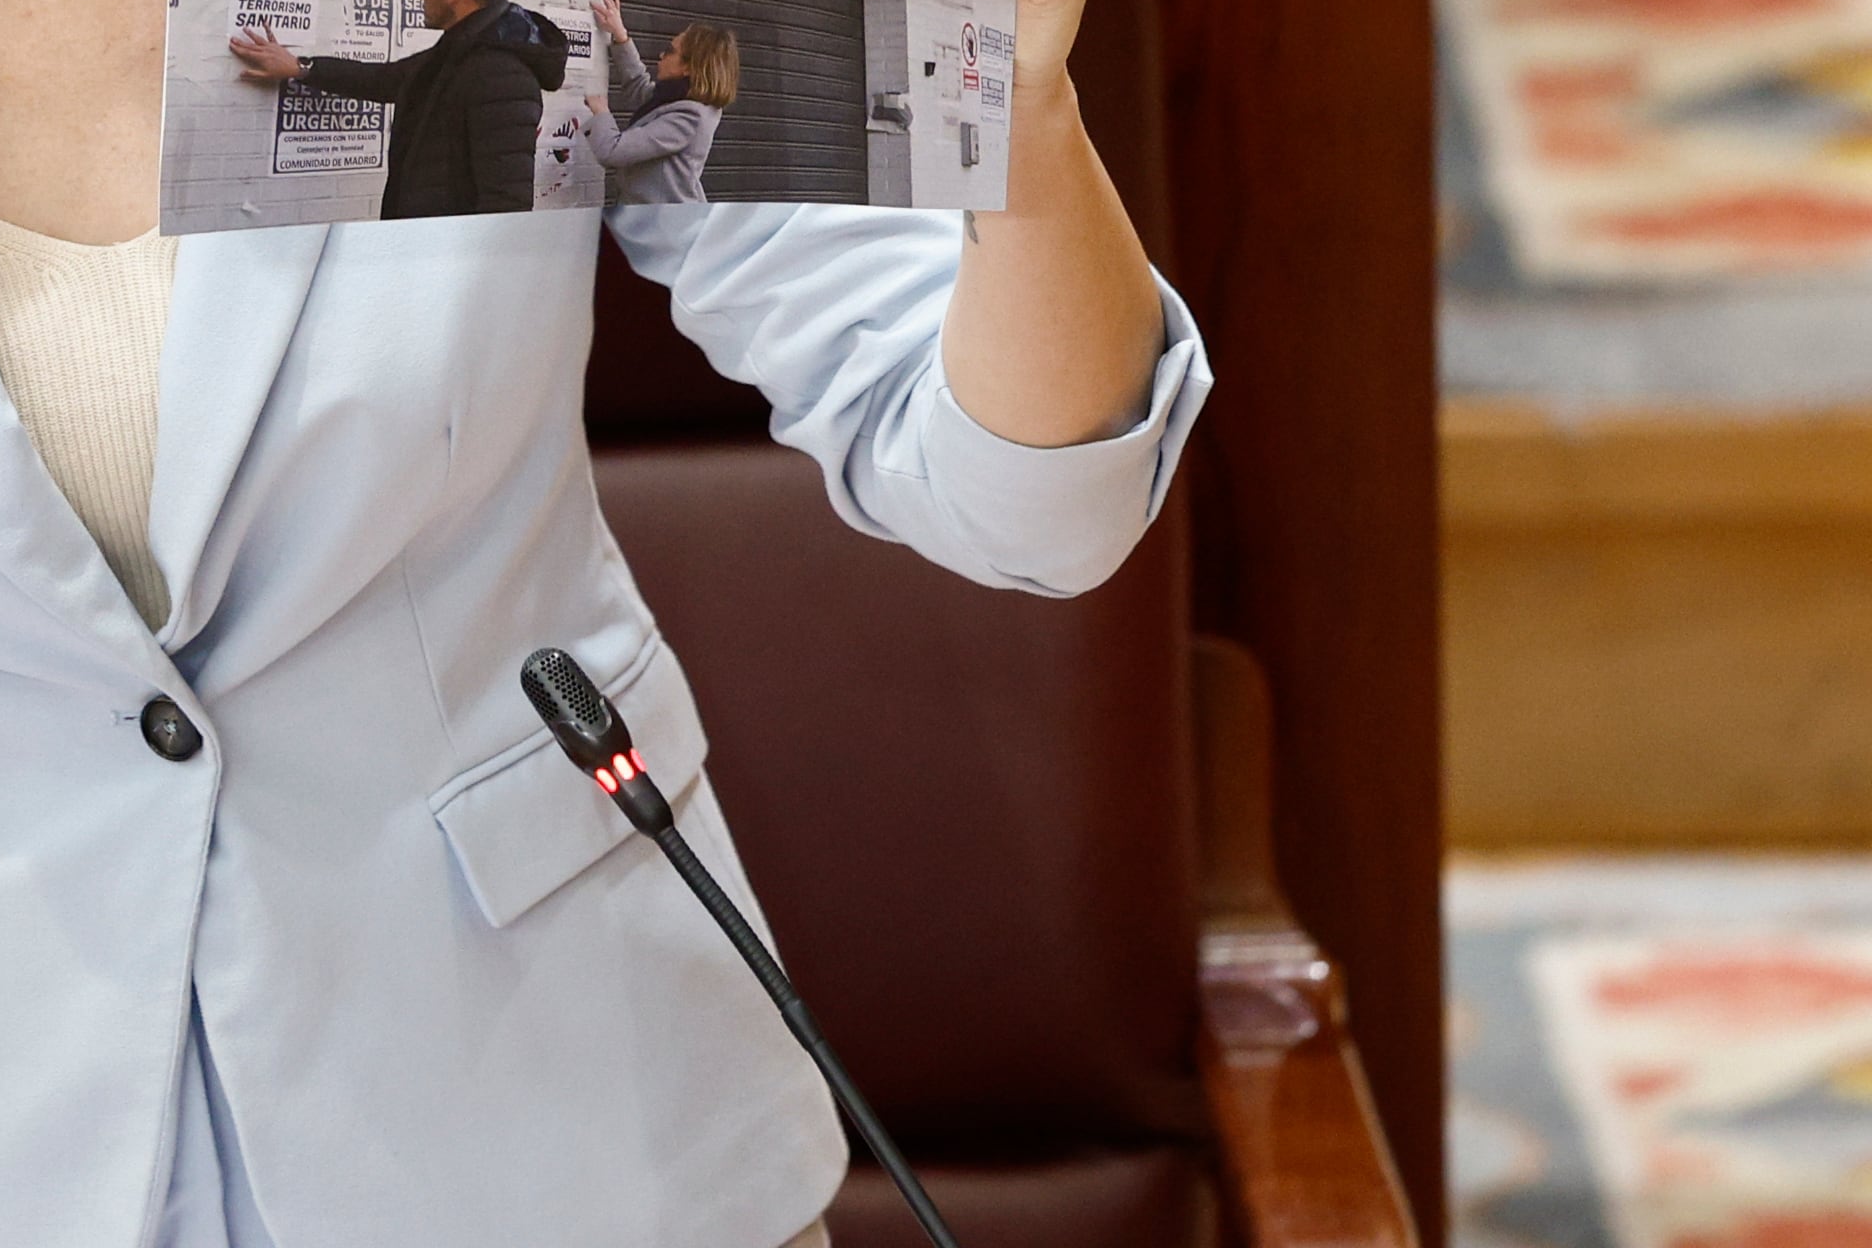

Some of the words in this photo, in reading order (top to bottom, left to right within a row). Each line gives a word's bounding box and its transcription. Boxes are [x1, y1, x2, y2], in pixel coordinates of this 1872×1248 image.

[238, 0, 311, 14] TERRORISMO
[235, 13, 311, 30] SANITARIO
[353, 51, 386, 60] MADRID
[282, 97, 358, 112] SERVICIO
[362, 100, 382, 112] DE
[282, 114, 380, 130] URGENCIAS
[333, 134, 346, 142] CON
[280, 158, 330, 169] COMUNIDAD
[332, 158, 341, 167] DE
[344, 156, 378, 166] MADRID
